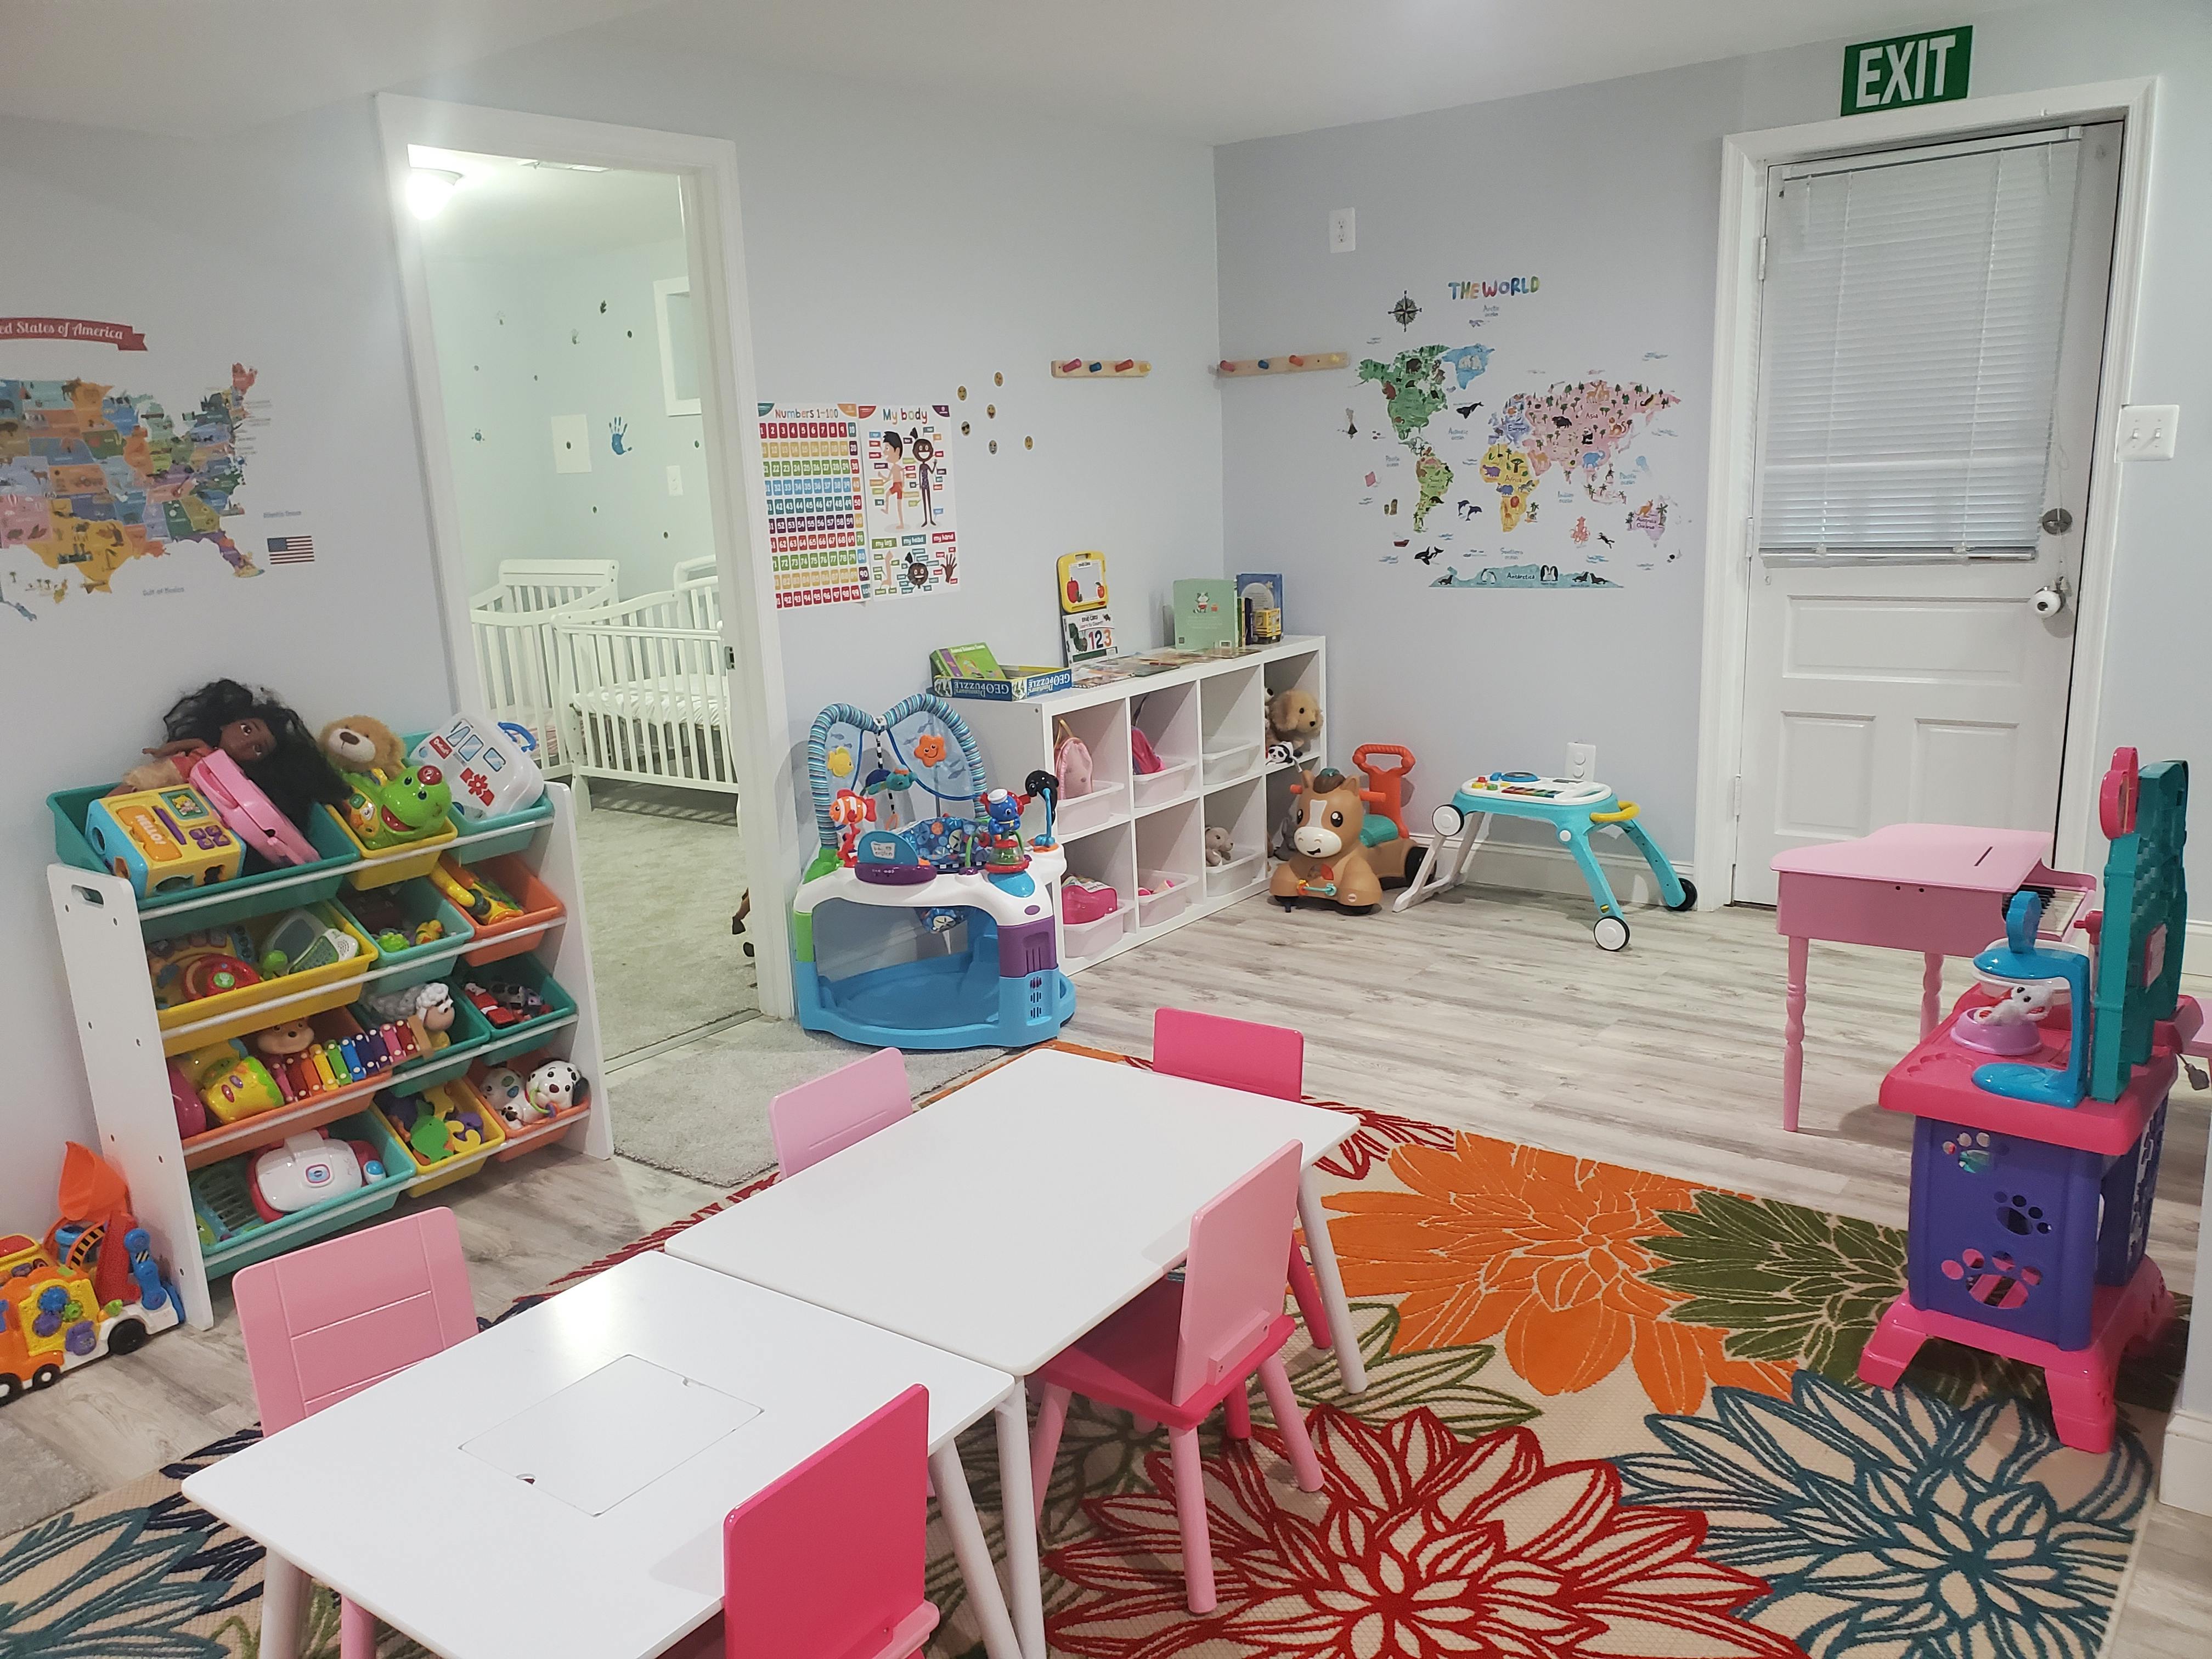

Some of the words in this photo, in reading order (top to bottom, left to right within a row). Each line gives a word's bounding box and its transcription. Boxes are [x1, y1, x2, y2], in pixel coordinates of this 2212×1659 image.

[1856, 35, 1956, 108] EXIT
[1448, 281, 1480, 300] THE
[1482, 276, 1540, 297] WORLD
[17, 321, 54, 334] States
[59, 322, 70, 337] of
[72, 323, 123, 340] America
[775, 409, 814, 418] Numbers
[817, 409, 838, 418] 1-100
[883, 409, 898, 425] My
[901, 407, 927, 424] body
[1506, 572, 1535, 580] Antarctica
